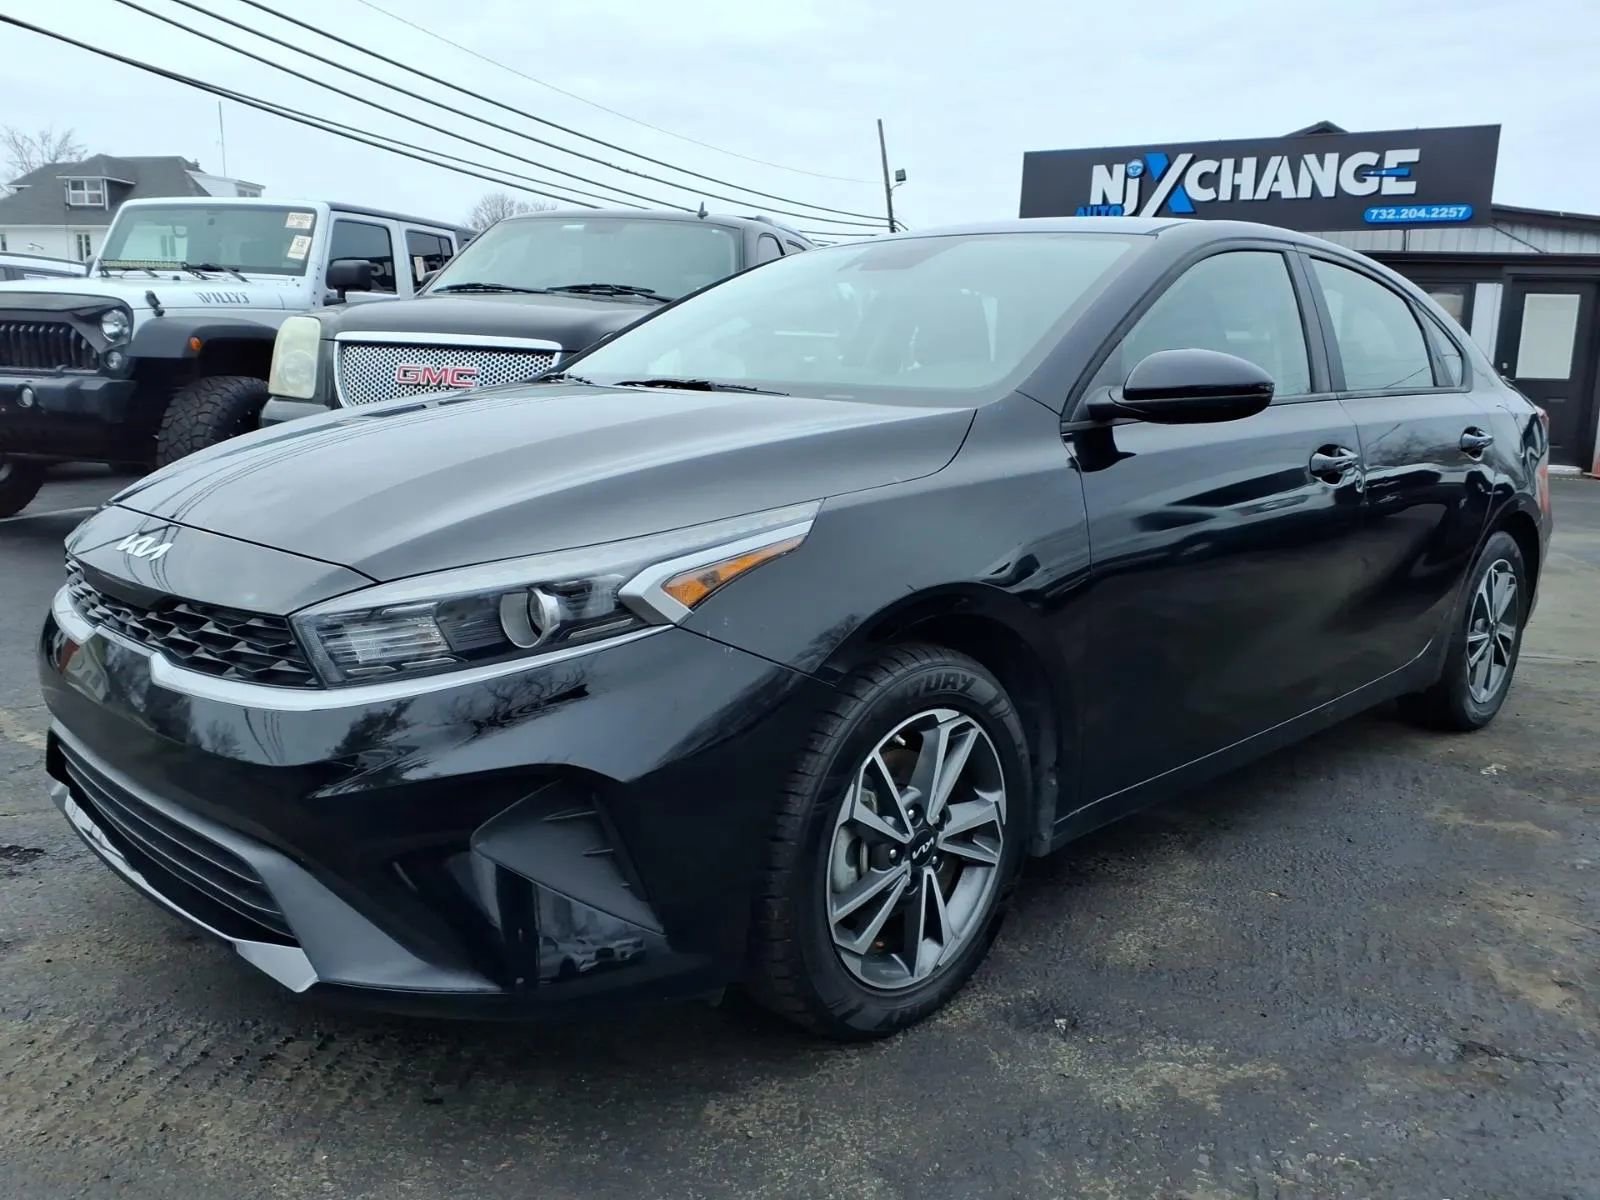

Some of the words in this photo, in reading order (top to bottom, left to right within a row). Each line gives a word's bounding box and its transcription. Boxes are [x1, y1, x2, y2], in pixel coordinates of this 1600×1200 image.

[1370, 207, 1467, 220] 732.204.2257
[194, 291, 250, 304] WILLYS
[395, 364, 480, 388] GMC
